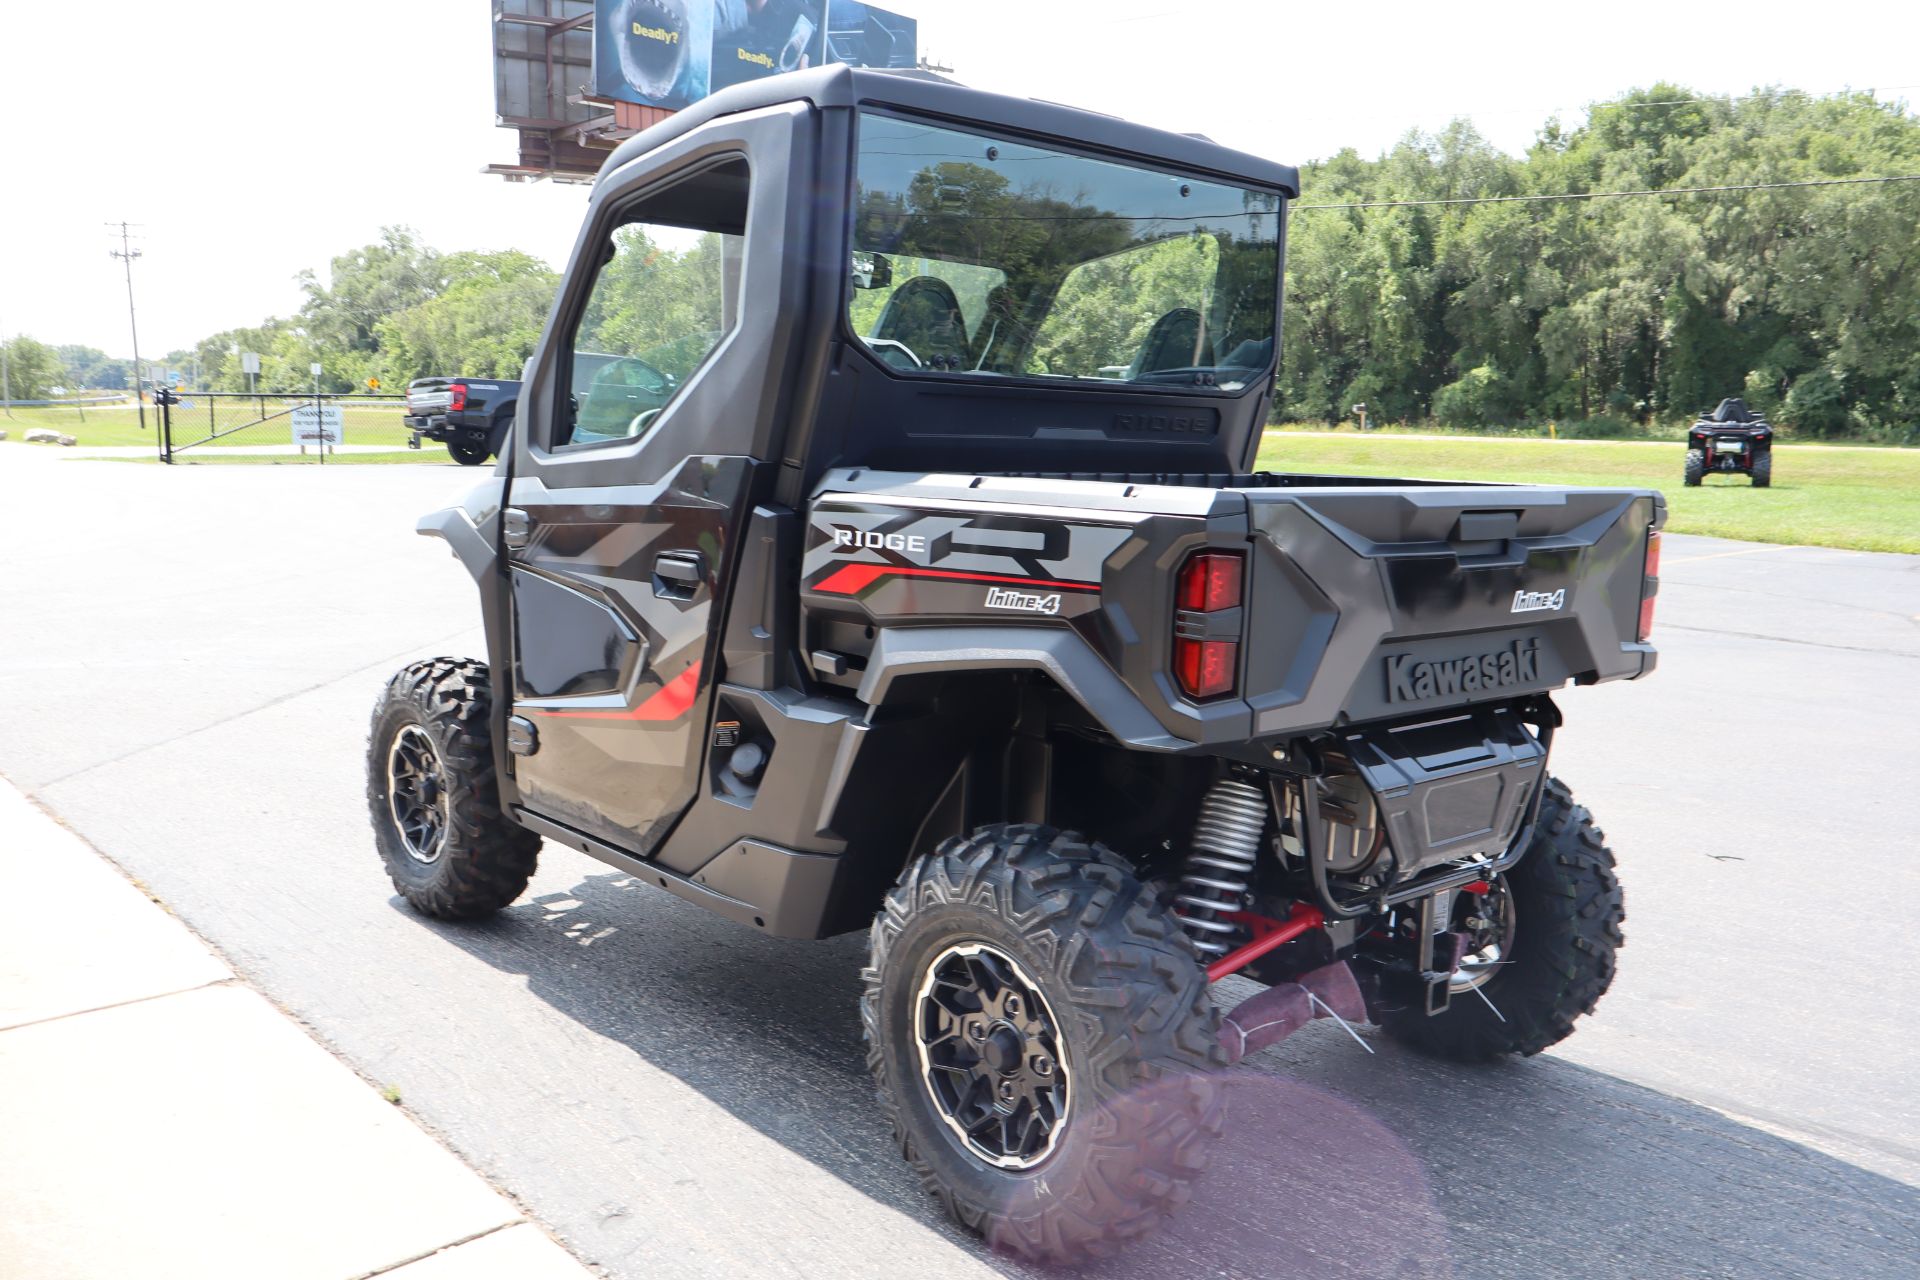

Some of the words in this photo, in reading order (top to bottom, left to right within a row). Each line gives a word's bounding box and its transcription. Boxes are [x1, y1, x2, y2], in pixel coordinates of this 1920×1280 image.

[632, 22, 679, 44] Deadly?
[737, 48, 774, 68] Deadly.
[1113, 413, 1209, 433] RIDGE
[833, 528, 926, 553] RIDGE
[984, 587, 1061, 614] Inline-4
[1383, 637, 1540, 703] Kawasaki
